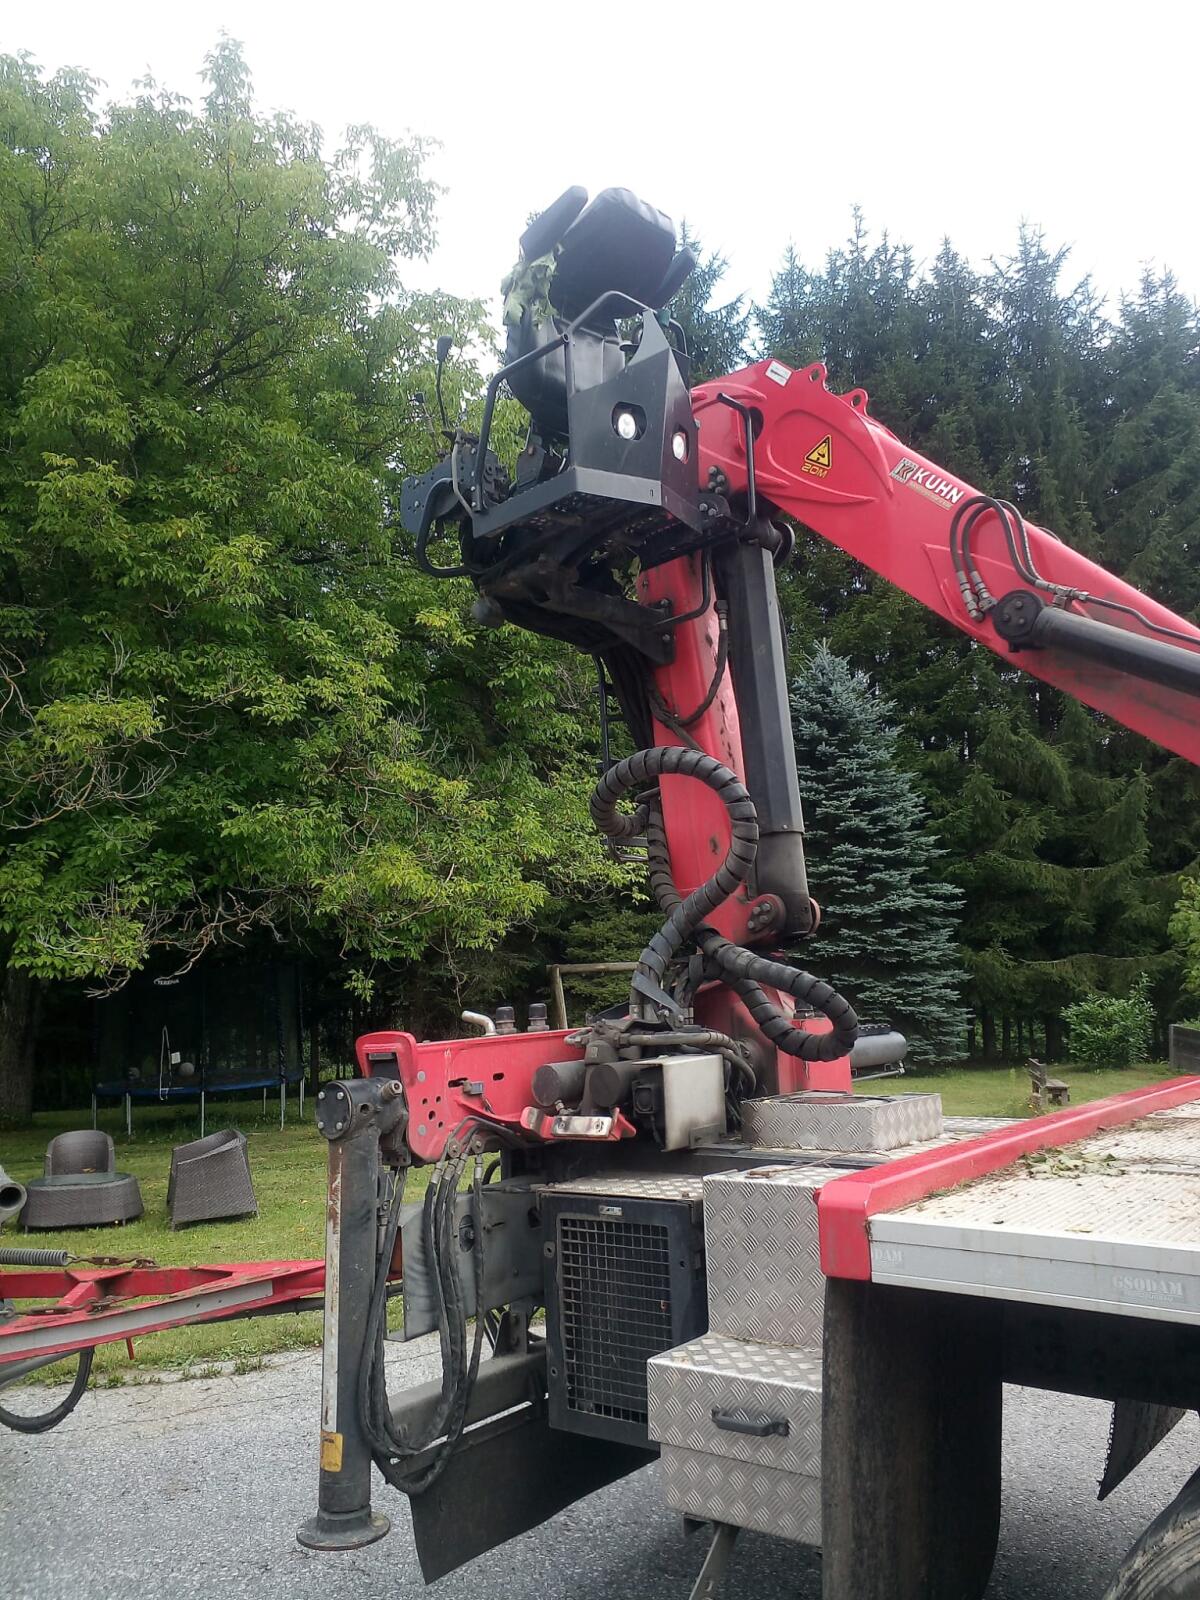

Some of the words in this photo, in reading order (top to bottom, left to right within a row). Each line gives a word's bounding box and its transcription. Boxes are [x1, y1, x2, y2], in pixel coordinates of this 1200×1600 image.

[801, 462, 828, 478] 20M
[912, 467, 964, 504] KUHN
[1112, 1275, 1183, 1296] GSODAM
